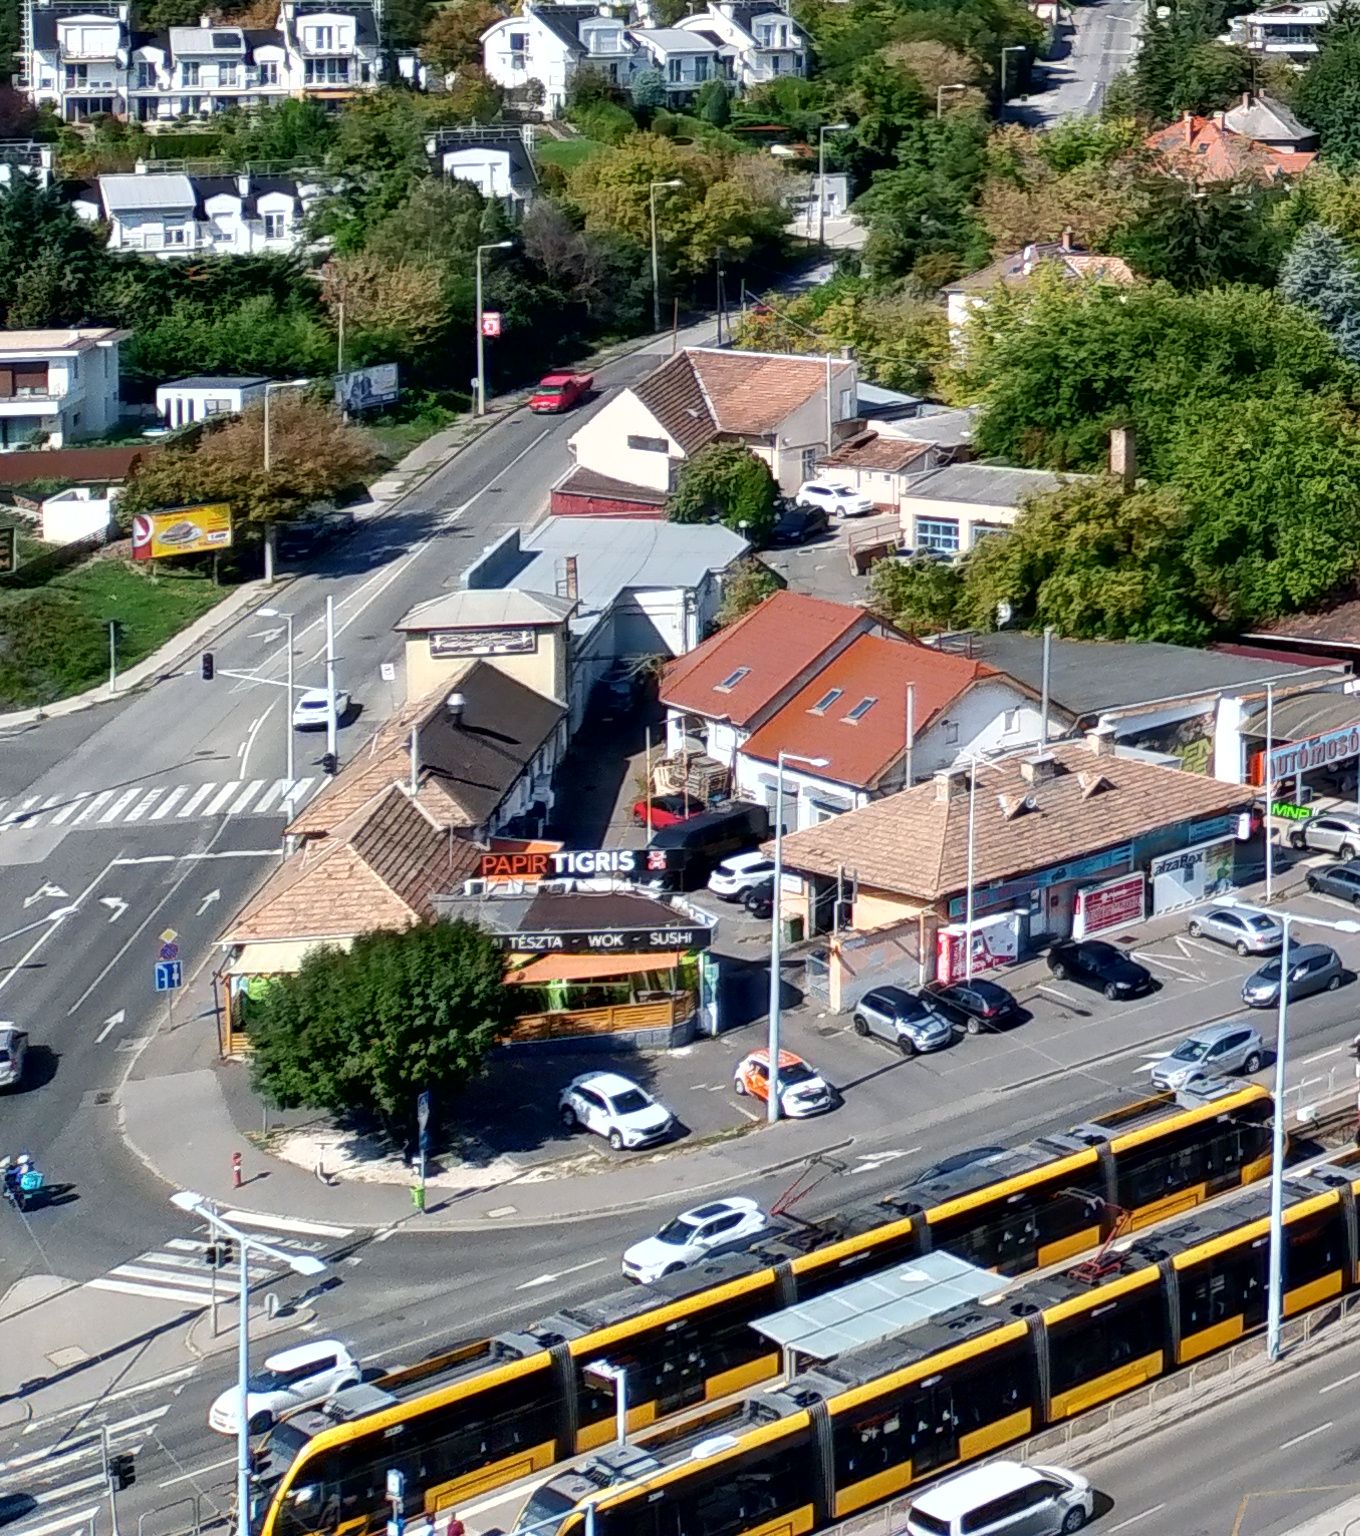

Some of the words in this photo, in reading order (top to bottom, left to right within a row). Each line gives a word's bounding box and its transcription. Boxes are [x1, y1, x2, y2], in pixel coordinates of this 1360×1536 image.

[549, 850, 636, 874] TIGRIS
[1154, 852, 1204, 876] alzaBox
[508, 934, 563, 950] TÉSZTA
[587, 933, 624, 948] WOK
[649, 931, 693, 945] SUSHI
